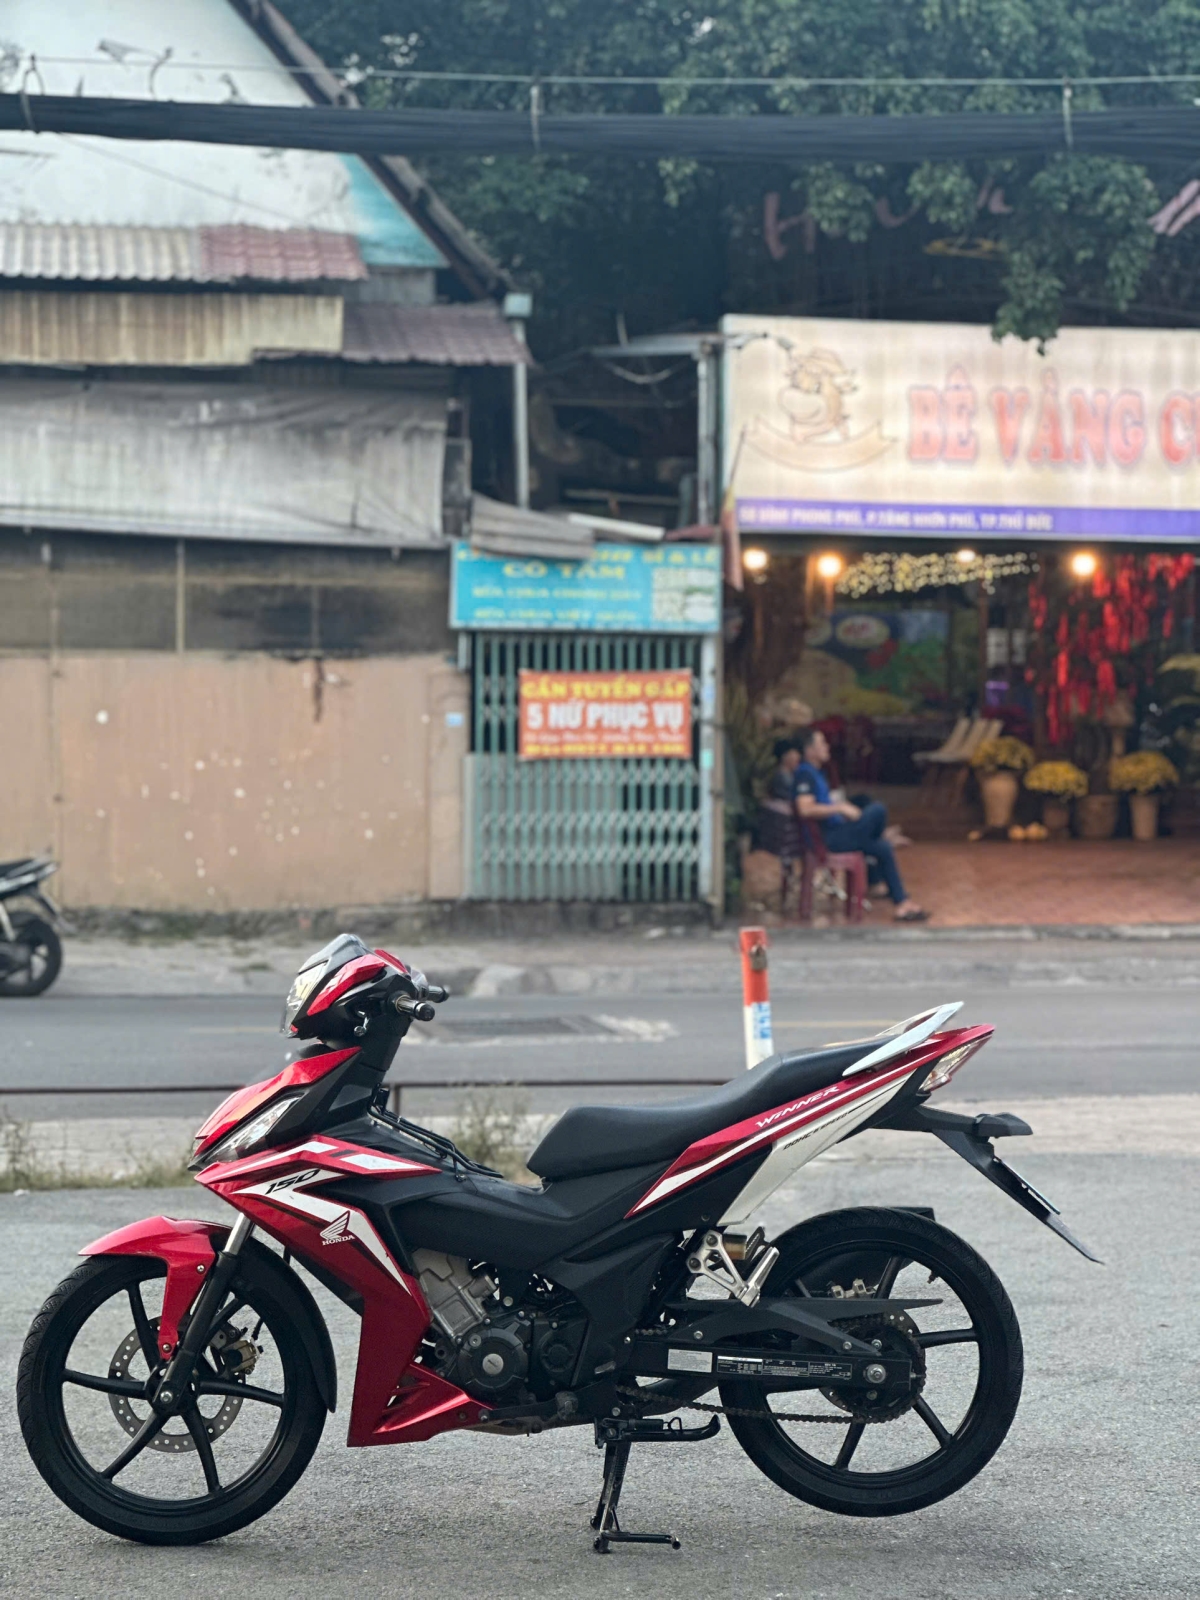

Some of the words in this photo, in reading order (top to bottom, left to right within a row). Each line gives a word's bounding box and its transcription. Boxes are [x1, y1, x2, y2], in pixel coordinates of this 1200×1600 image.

[908, 363, 978, 464] BÊ
[1158, 389, 1200, 471] C
[527, 703, 543, 729] 5
[587, 702, 649, 733] PHỤC
[652, 702, 684, 734] VỤ
[756, 1086, 840, 1128] WINNER
[265, 1168, 321, 1195] 150
[322, 1235, 355, 1246] HONDA
